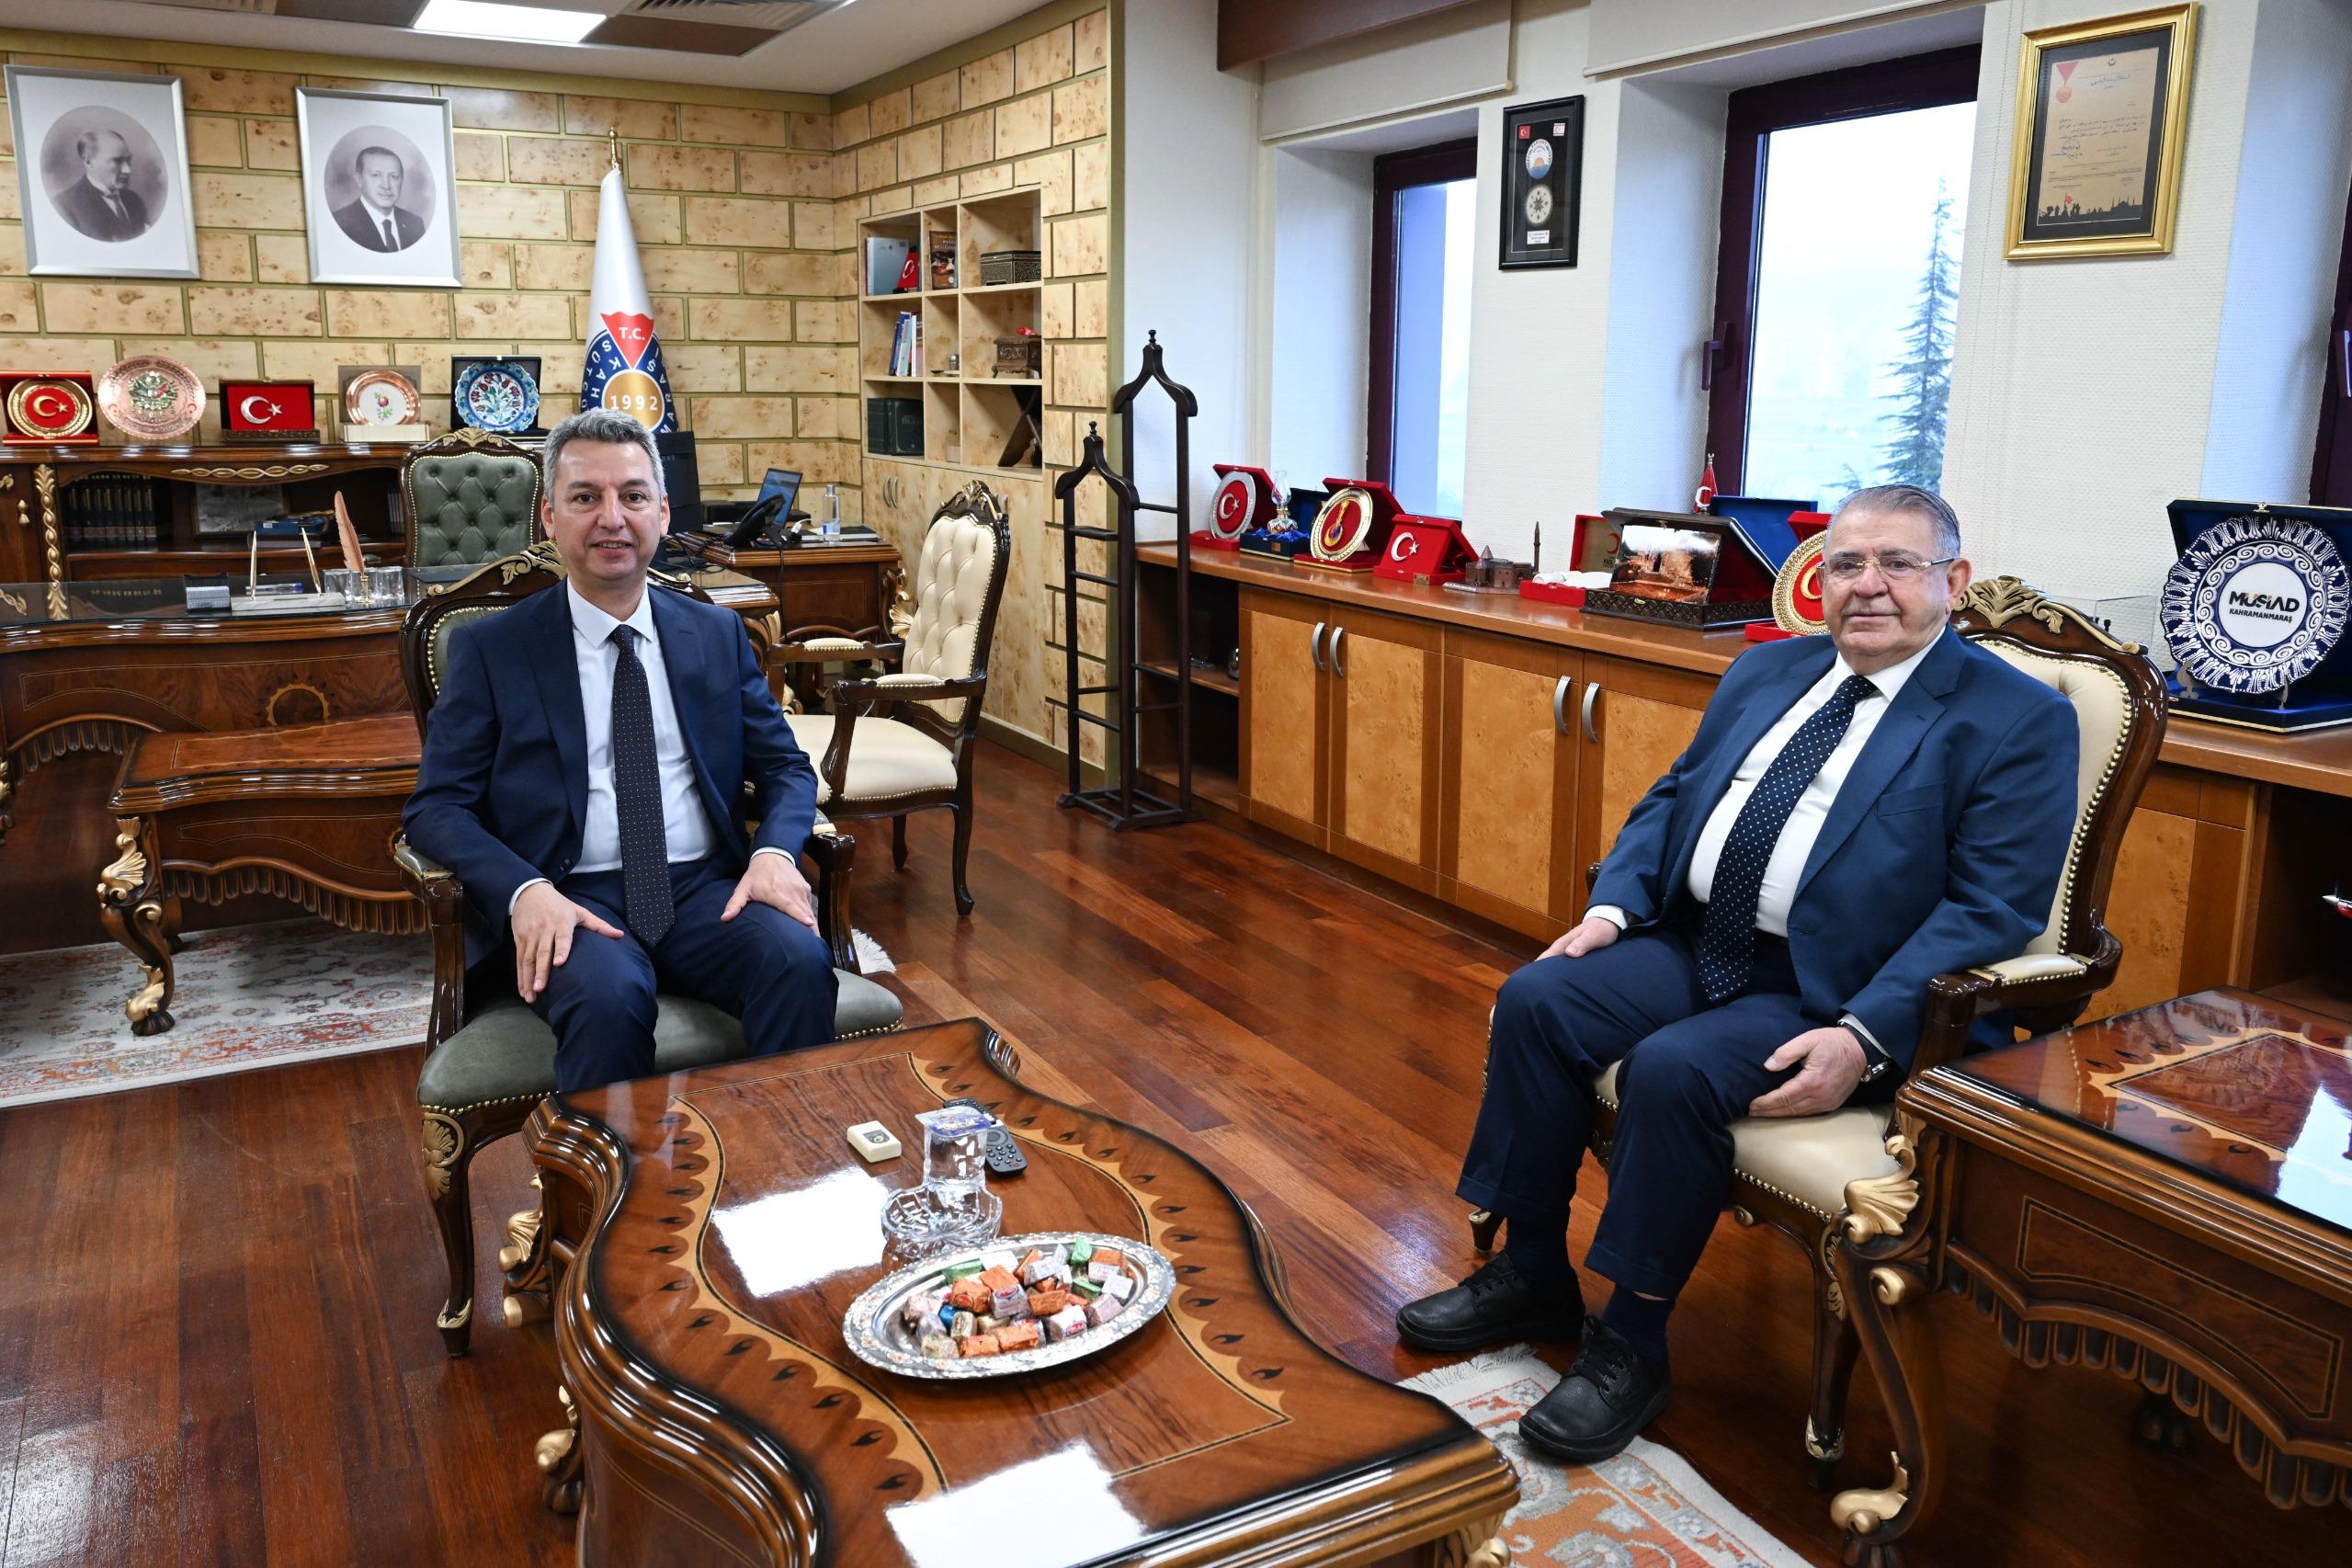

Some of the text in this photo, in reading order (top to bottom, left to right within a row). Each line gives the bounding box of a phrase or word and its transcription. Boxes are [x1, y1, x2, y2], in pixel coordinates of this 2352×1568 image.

[619, 326, 645, 340] T.C.
[609, 394, 658, 411] 1992
[2229, 608, 2293, 623] KAHRAMANMARAŞ
